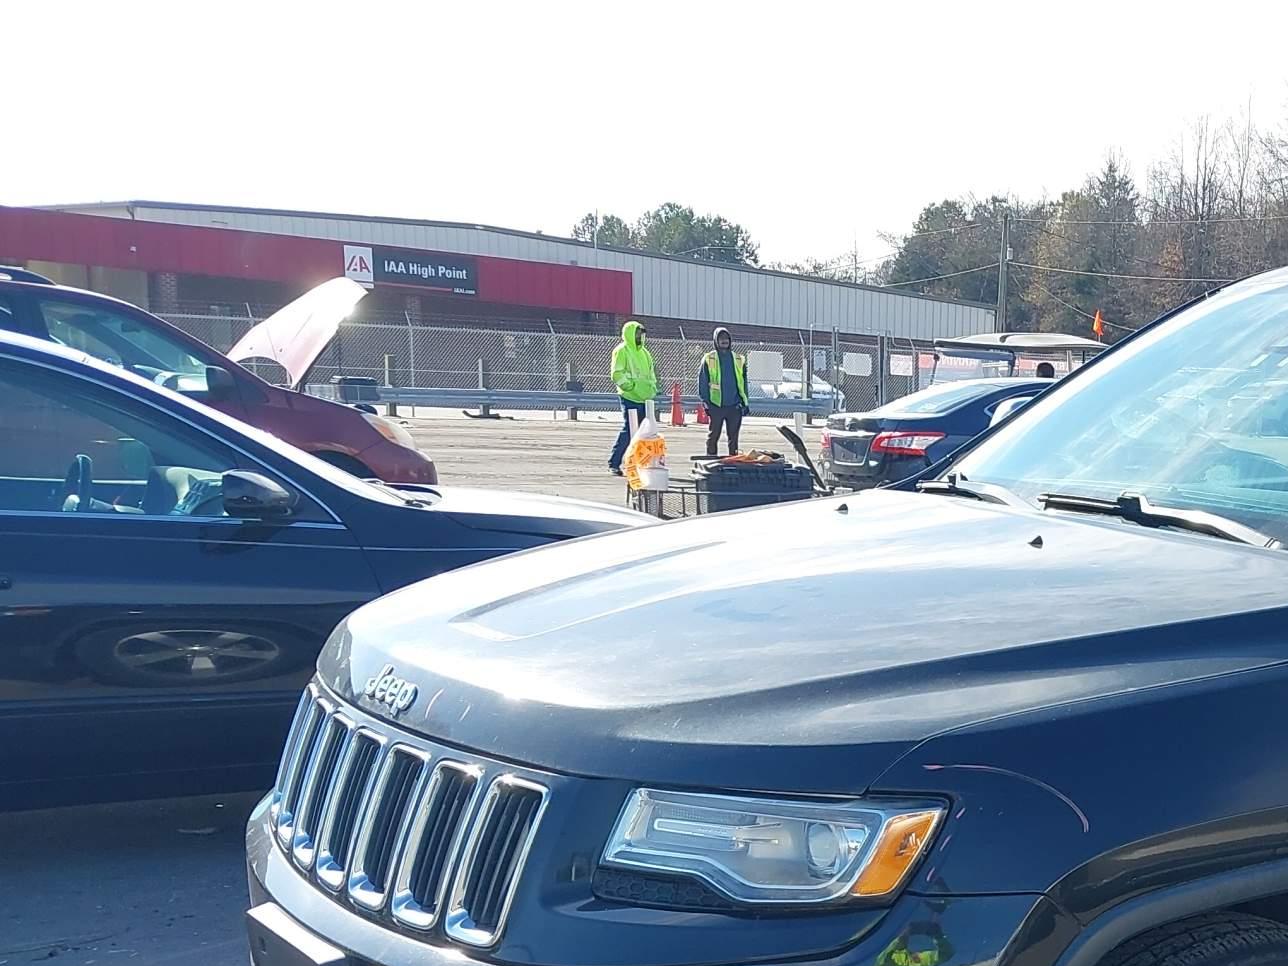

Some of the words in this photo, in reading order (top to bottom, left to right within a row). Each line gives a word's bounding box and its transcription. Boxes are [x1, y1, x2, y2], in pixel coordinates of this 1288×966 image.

[384, 260, 407, 274] IAA
[409, 262, 435, 279] High
[438, 265, 467, 280] Point
[365, 663, 418, 719] Jeep
